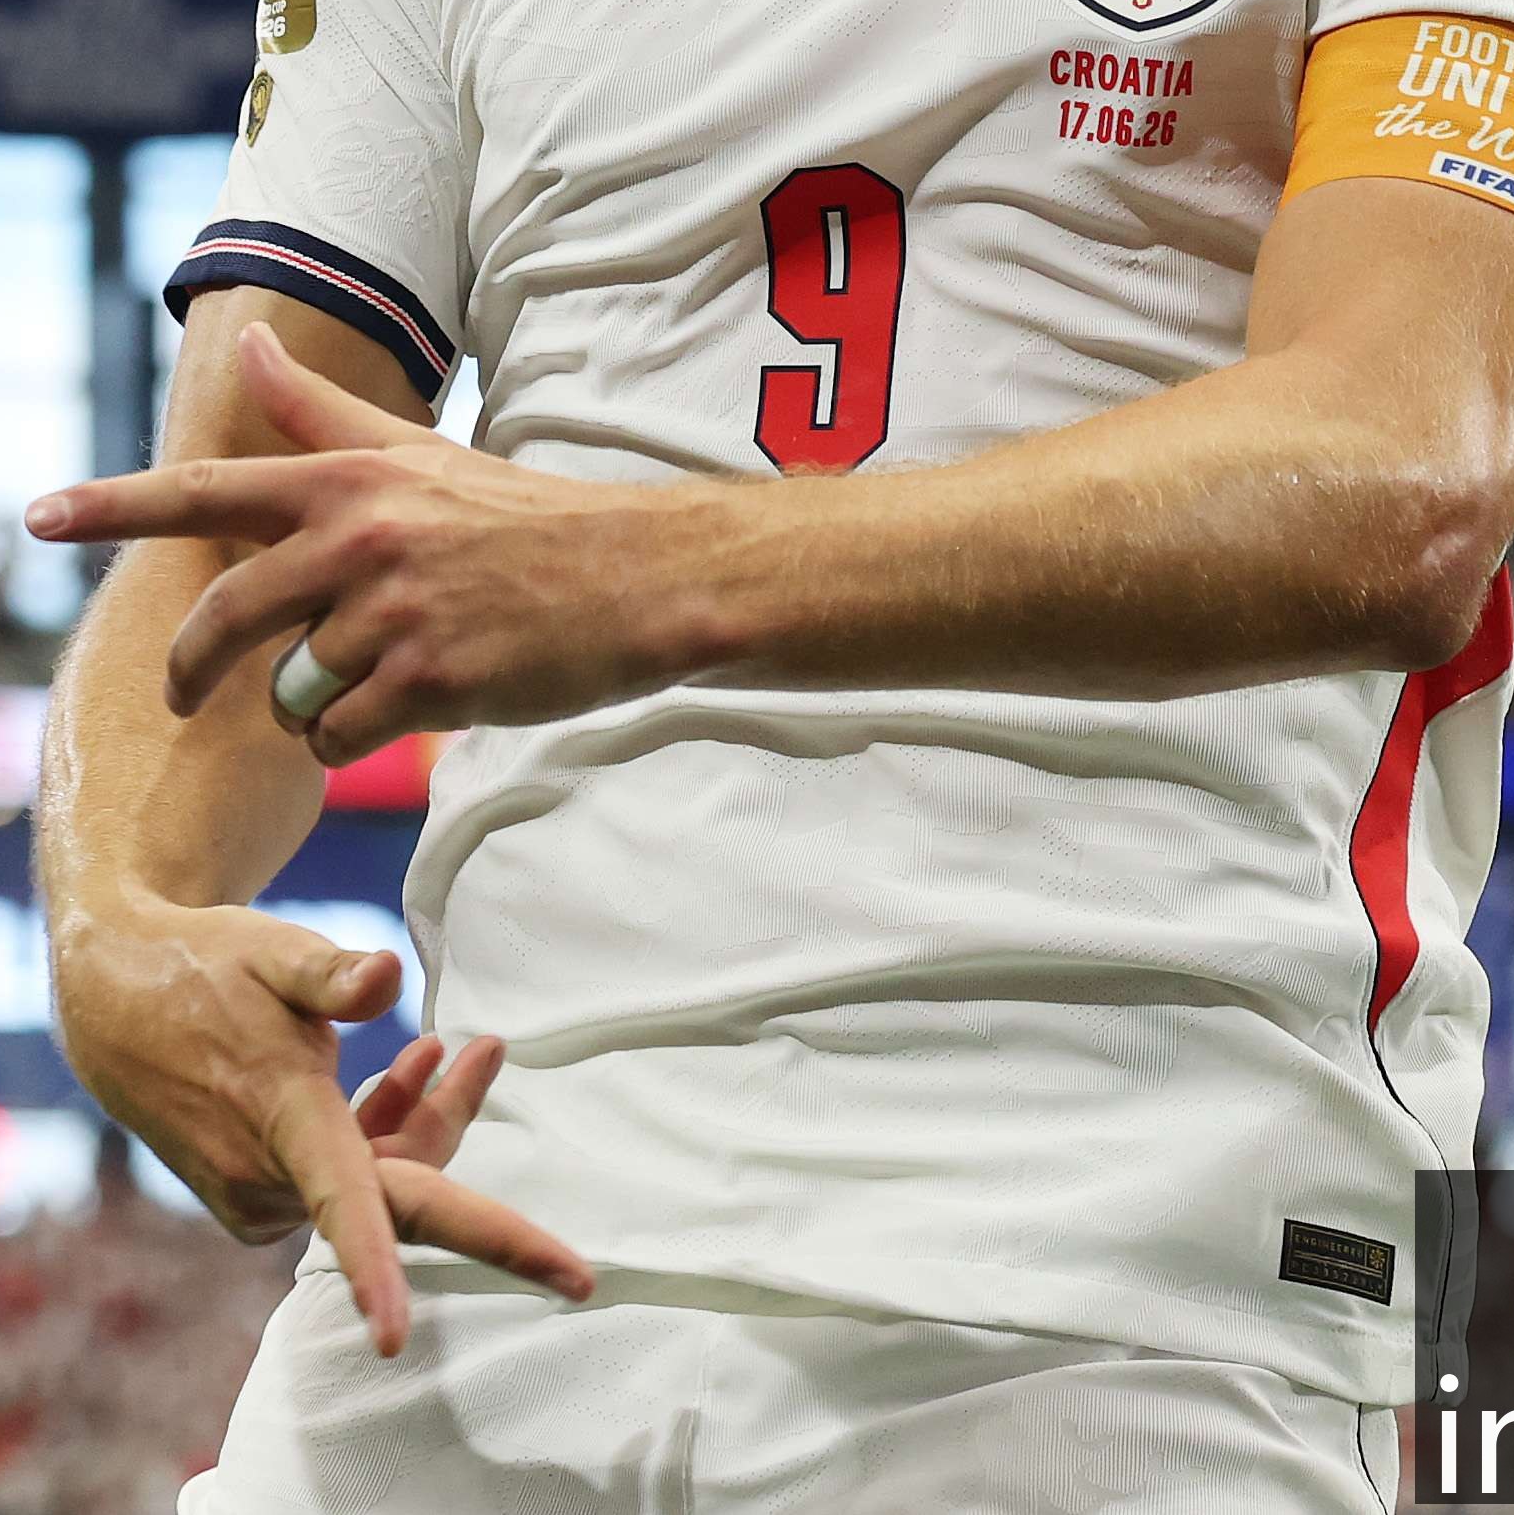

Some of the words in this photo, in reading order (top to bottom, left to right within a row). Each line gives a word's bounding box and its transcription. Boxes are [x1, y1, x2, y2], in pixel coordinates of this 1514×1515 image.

[1049, 49, 1194, 97] CROATIA
[1059, 100, 1178, 148] 17.06.26
[1374, 100, 1461, 139] the
[753, 162, 907, 478] 9
